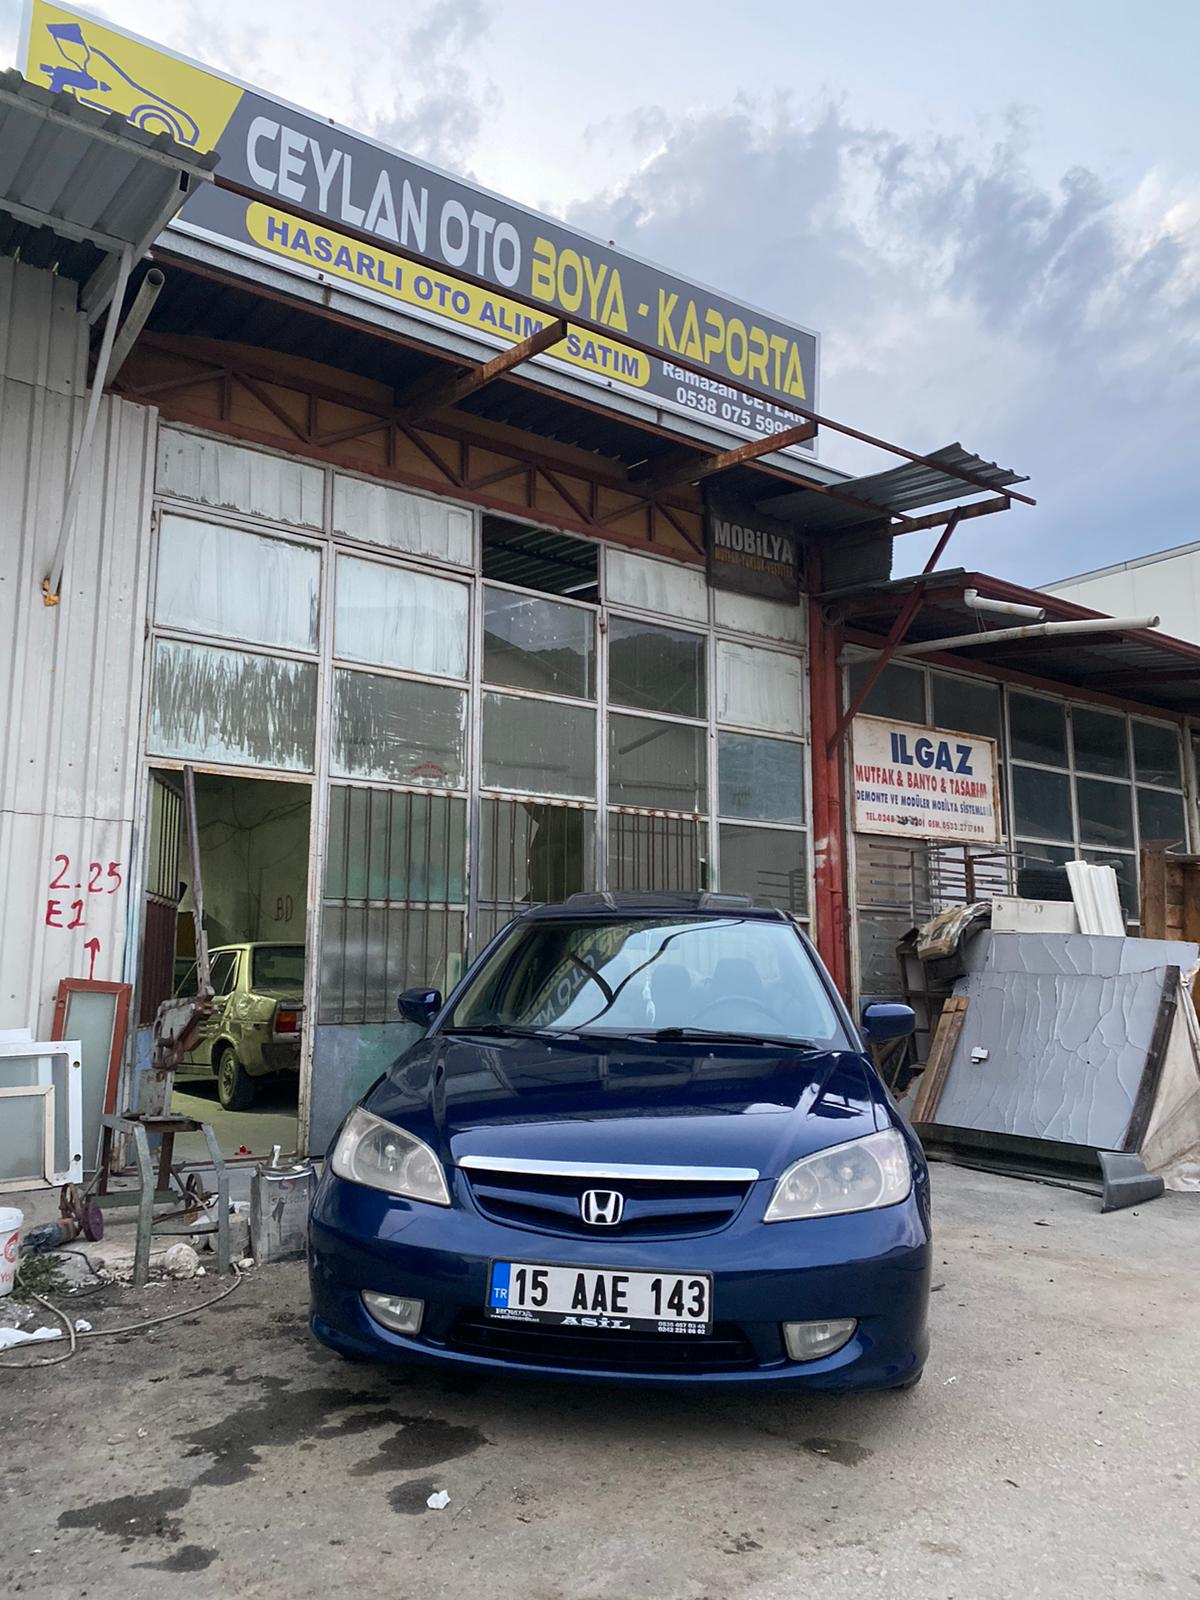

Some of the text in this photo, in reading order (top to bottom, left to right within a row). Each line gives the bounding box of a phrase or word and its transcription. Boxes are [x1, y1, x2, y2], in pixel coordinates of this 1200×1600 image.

[246, 115, 428, 253] CEYLAN
[440, 199, 521, 287] OTO
[531, 237, 629, 332] BOYA
[657, 288, 806, 400] KAPORTA
[266, 216, 640, 380] HASARLI OTO ALIM SATIM
[662, 361, 738, 401] Ramazan
[676, 387, 717, 414] 0538
[721, 403, 751, 426] 075
[890, 732, 973, 776] ILGAZ
[855, 765, 895, 786] MUTFAK
[896, 770, 904, 787] &
[906, 771, 938, 792] BANYO
[940, 777, 947, 793] &
[856, 790, 888, 804] DEMONTE
[890, 794, 899, 805] VE
[900, 794, 930, 809] MODÜLER
[49, 854, 122, 894] 2.25
[494, 1288, 507, 1299] TR
[515, 1268, 706, 1317] 15 AAE 143
